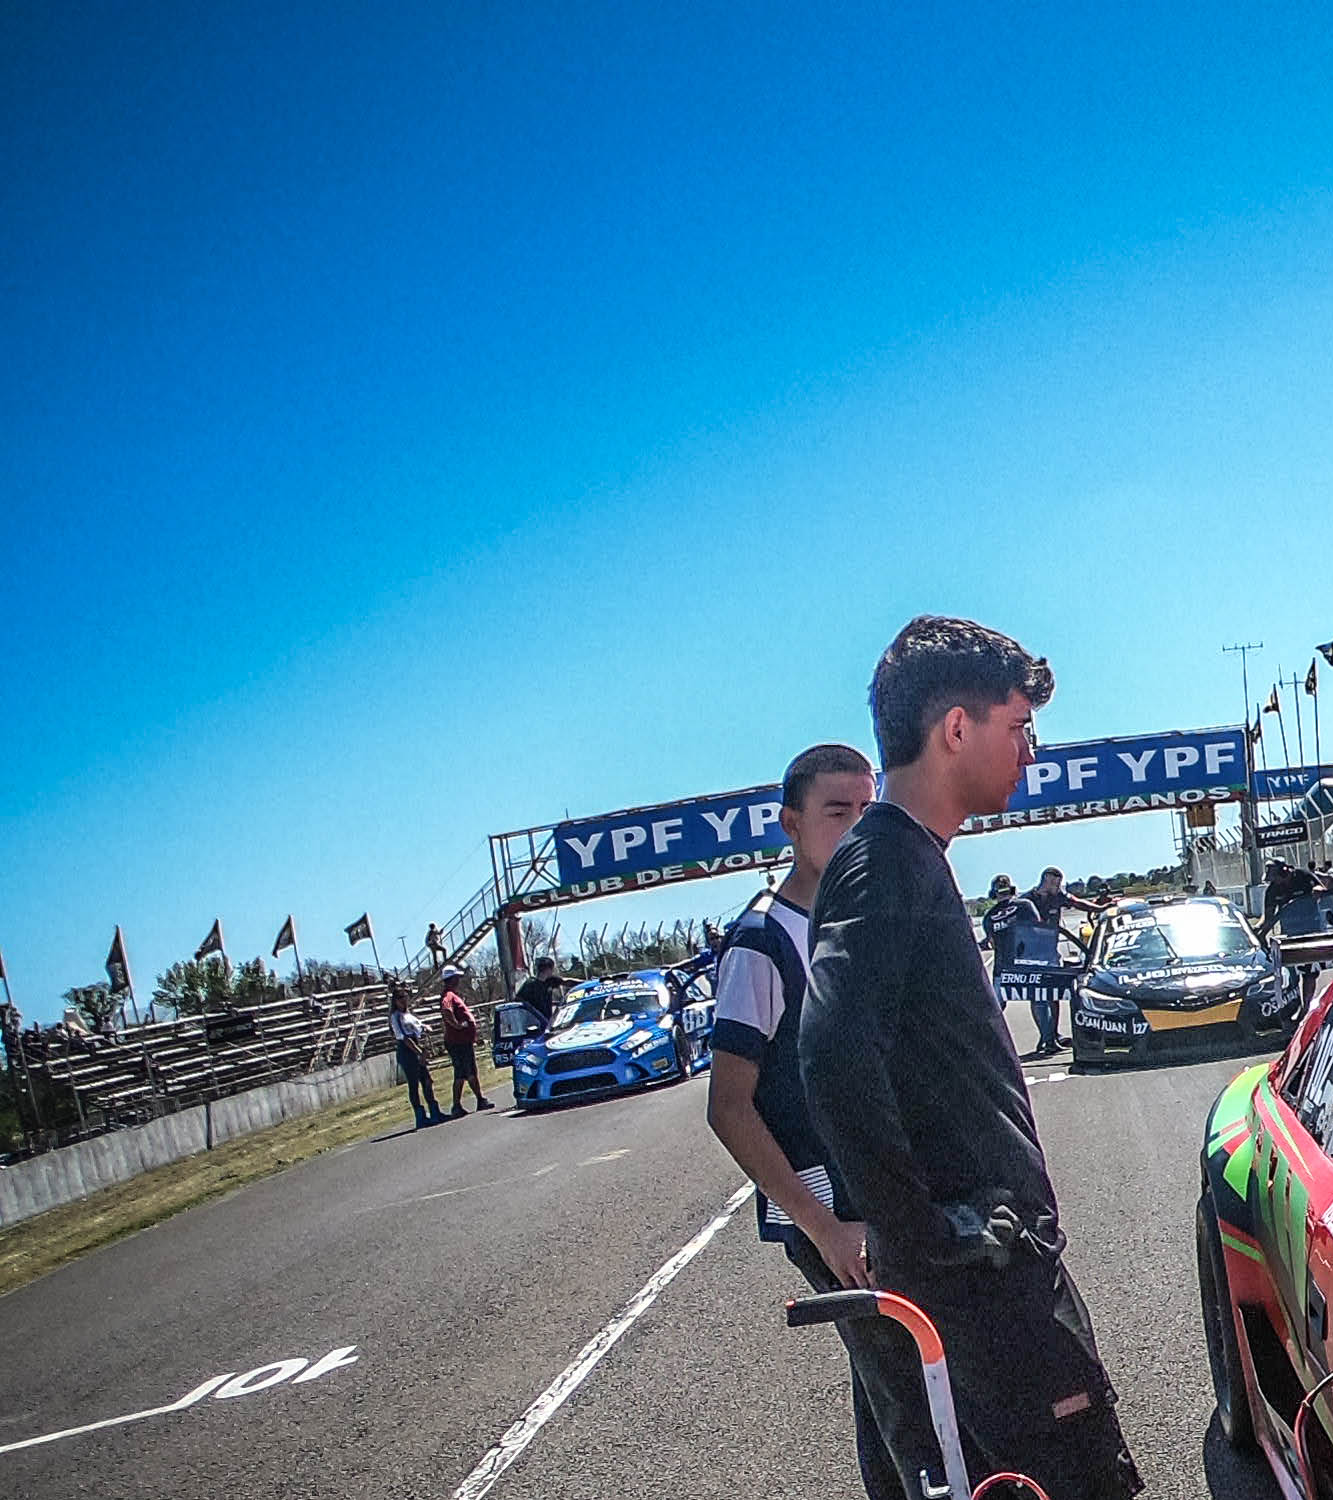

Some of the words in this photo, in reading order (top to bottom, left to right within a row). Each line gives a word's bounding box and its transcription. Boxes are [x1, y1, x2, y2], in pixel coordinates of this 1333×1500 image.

[1025, 756, 1098, 796] PF
[1117, 741, 1237, 782] YPF
[1267, 773, 1310, 788] YPF
[960, 785, 1232, 831] NTRERRIANOS
[564, 817, 684, 869] YPF
[701, 801, 784, 843] YP
[522, 874, 624, 905] CLUB
[636, 863, 686, 885] DE
[698, 844, 795, 873] VOLA
[1106, 929, 1143, 950] 127
